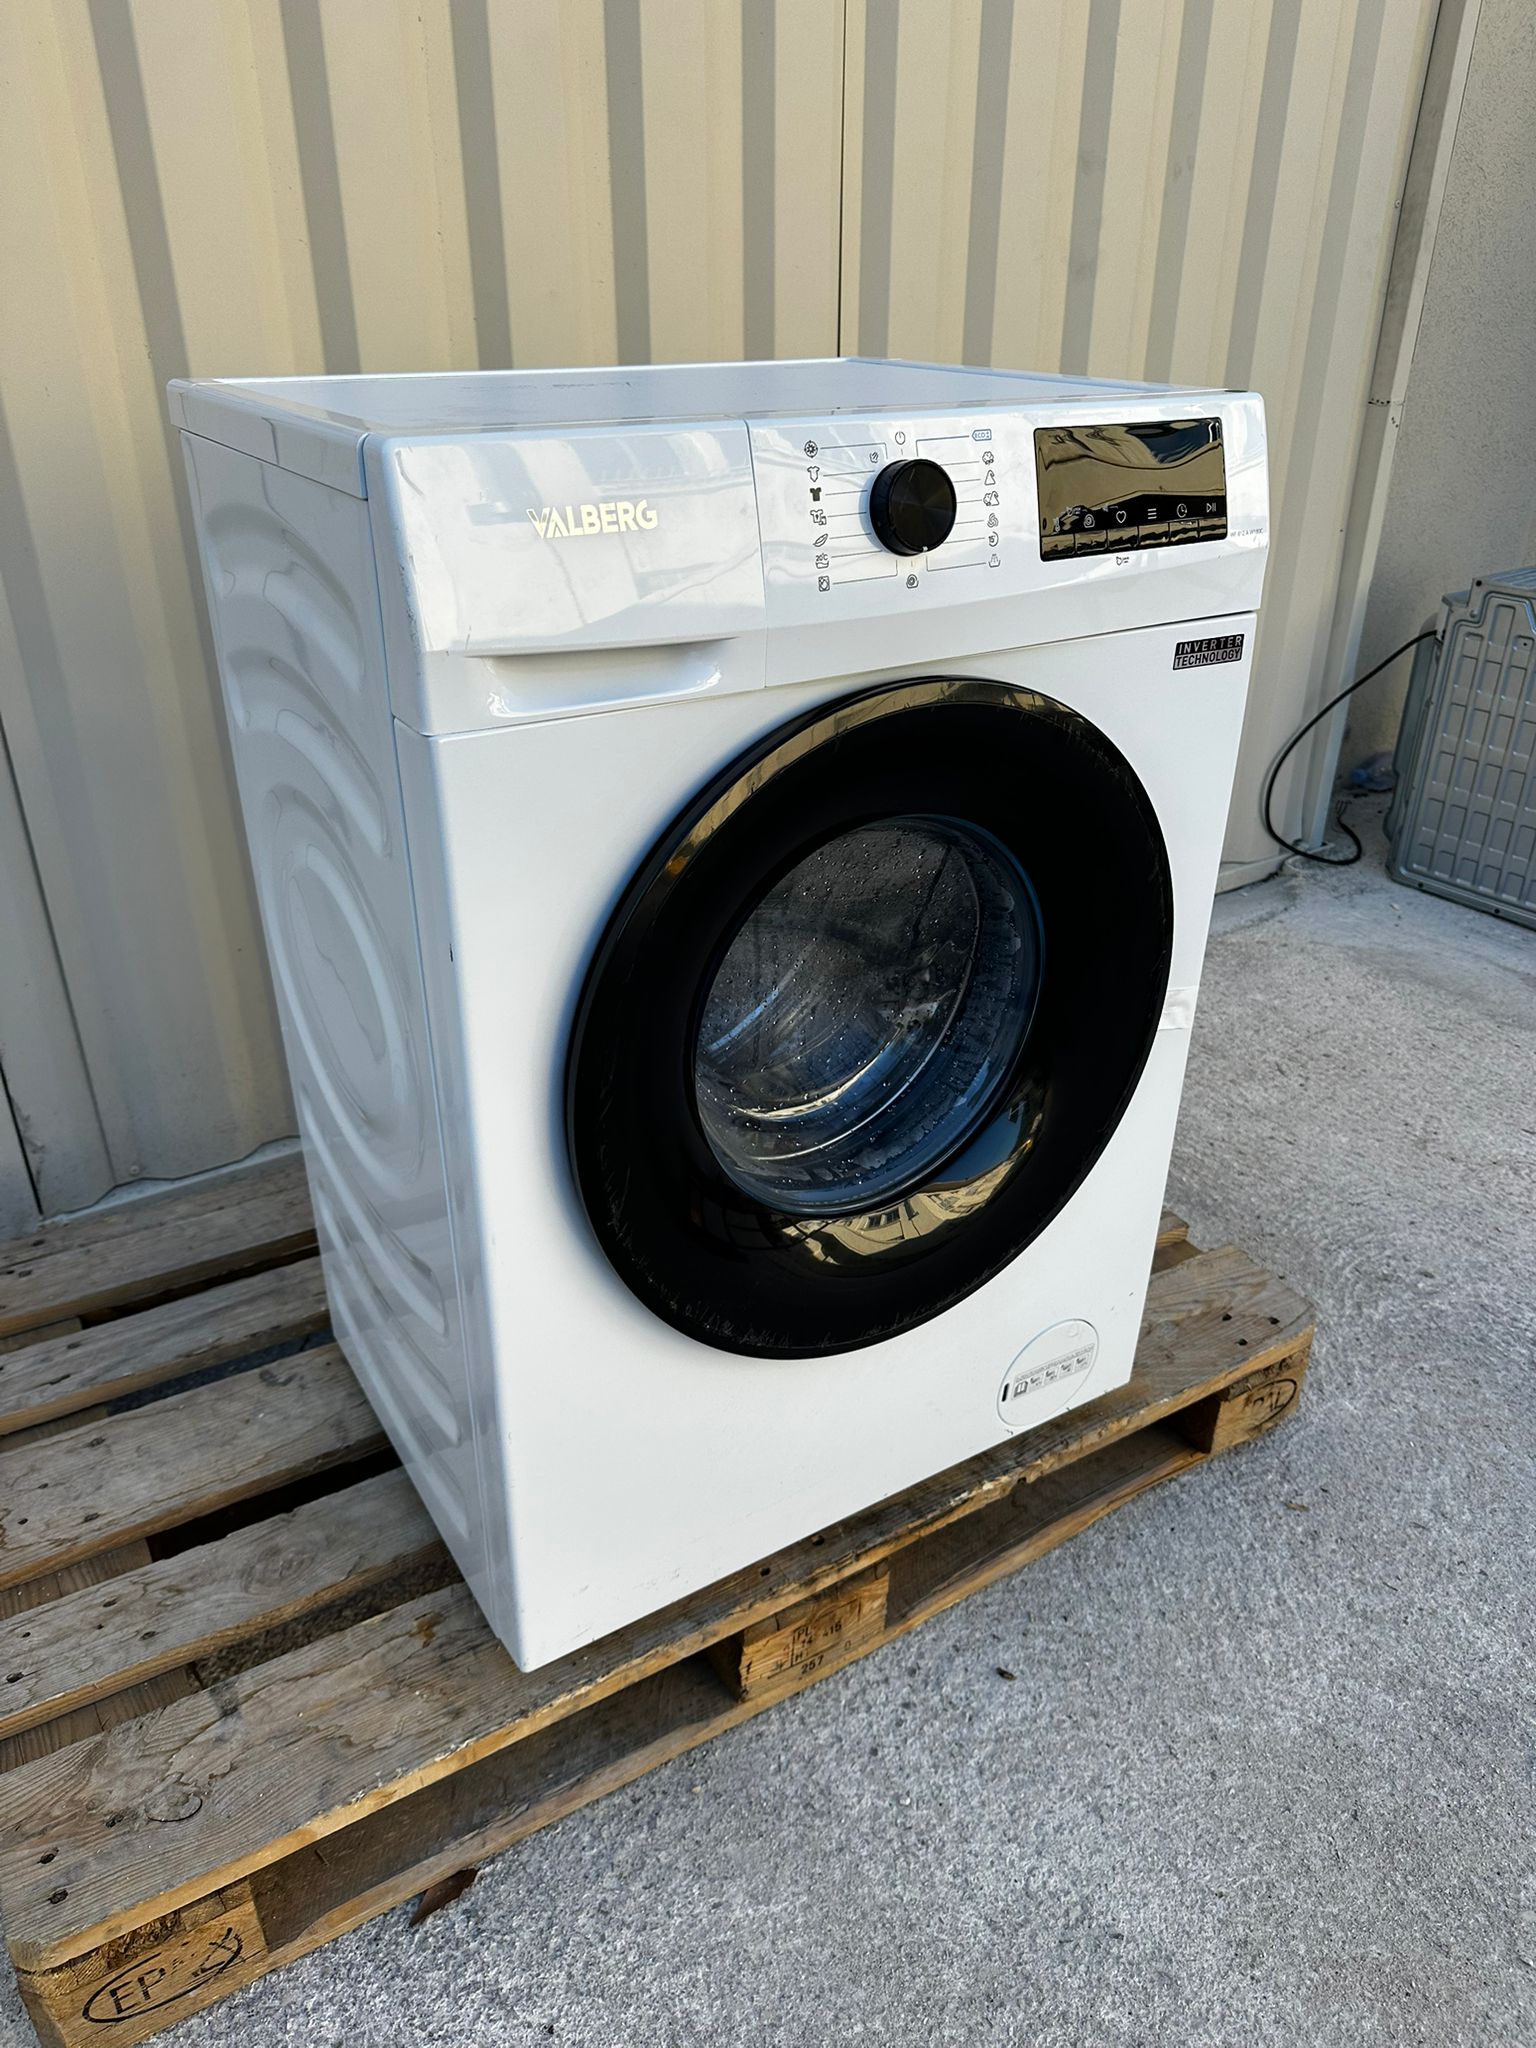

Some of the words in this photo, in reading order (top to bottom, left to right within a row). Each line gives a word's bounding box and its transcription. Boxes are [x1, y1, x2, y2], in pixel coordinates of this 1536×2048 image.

[526, 499, 658, 540] VALBERG
[1178, 635, 1242, 654] INVERTER
[1175, 648, 1241, 667] TECHNOLOGY
[801, 1655, 824, 1675] 257
